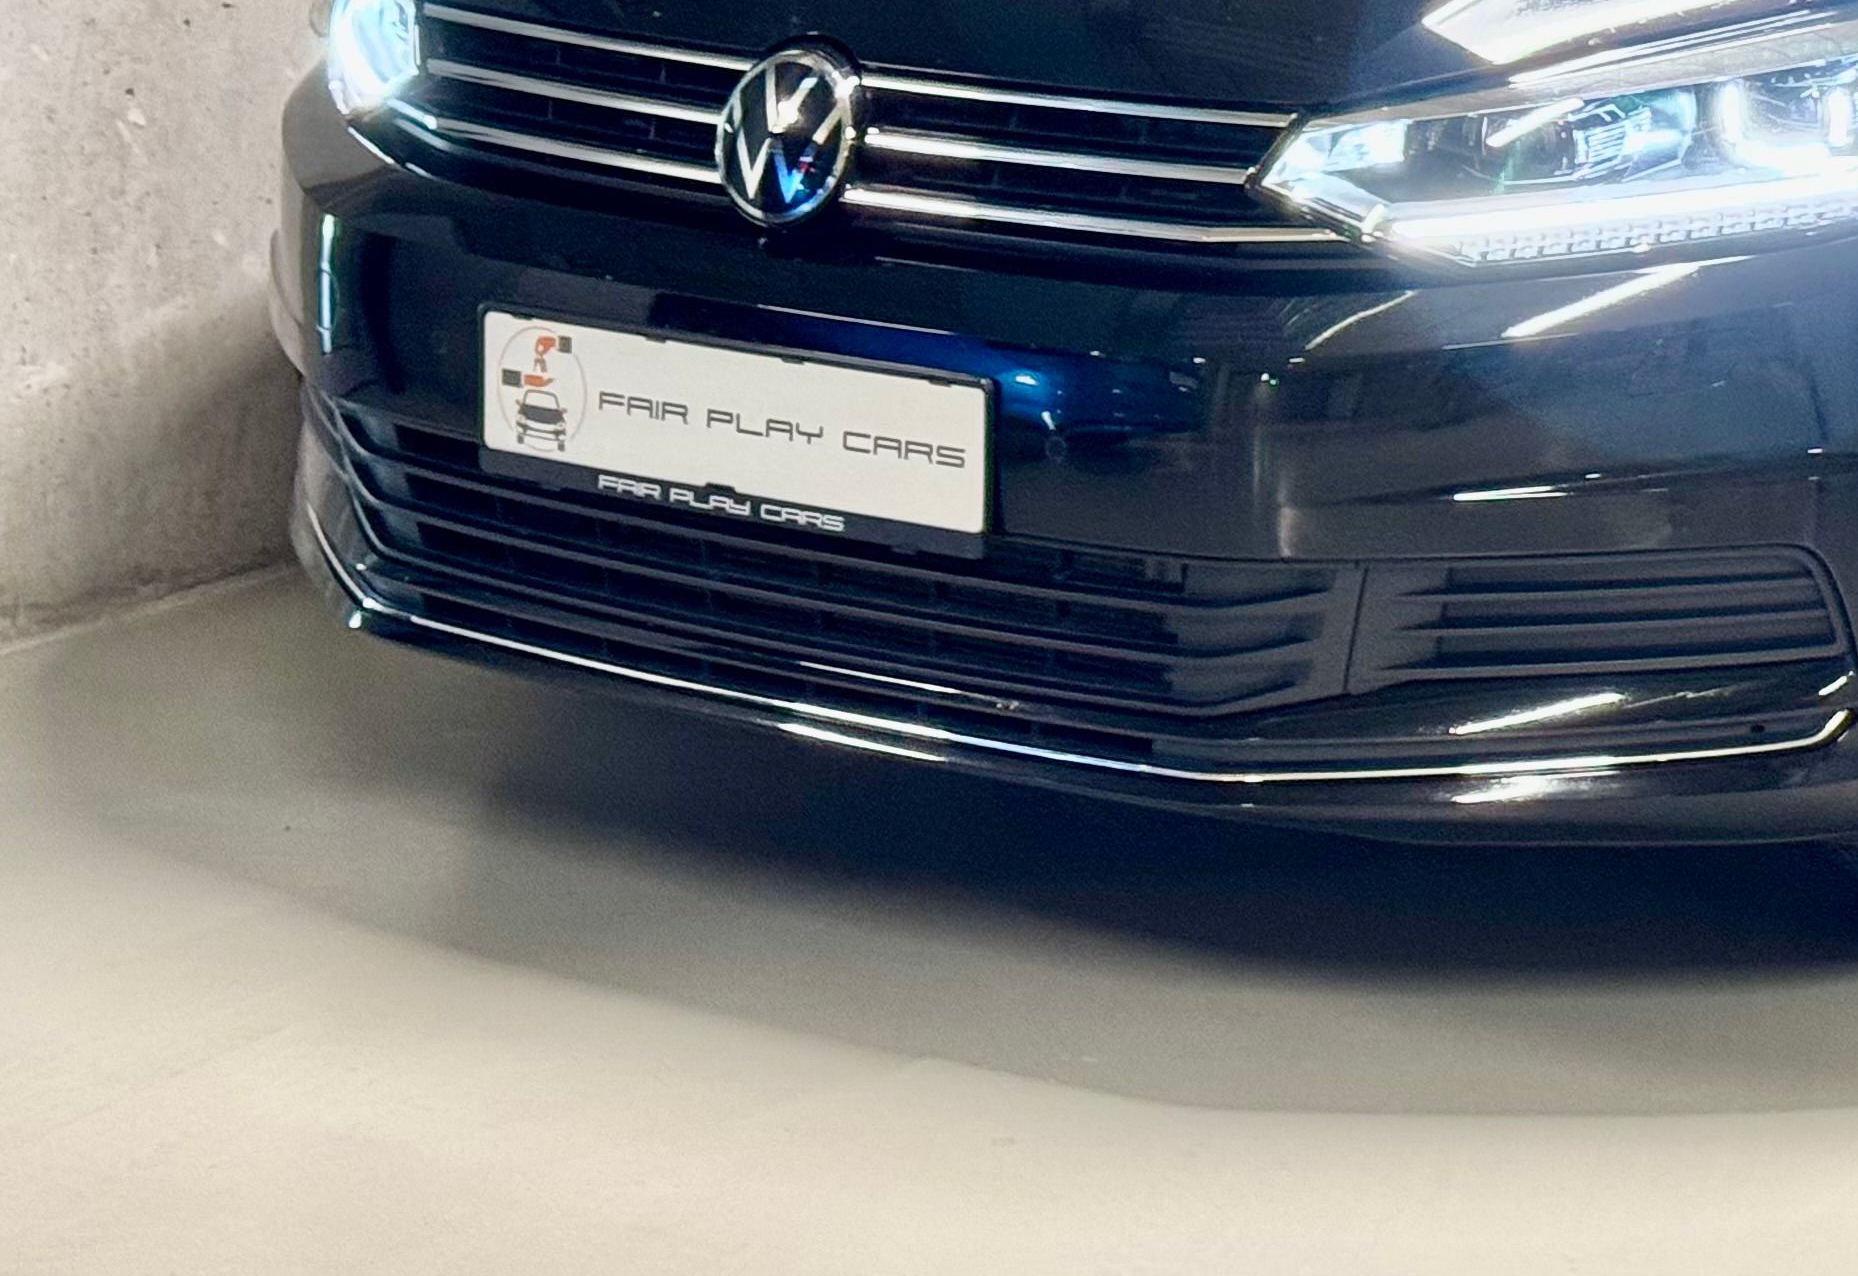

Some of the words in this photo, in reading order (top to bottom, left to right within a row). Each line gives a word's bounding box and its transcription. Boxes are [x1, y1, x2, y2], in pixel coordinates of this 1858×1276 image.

[717, 53, 850, 220] VW
[598, 391, 688, 425] FAIR
[706, 408, 824, 445] PLAY
[843, 430, 966, 469] CARS
[598, 474, 661, 500] FAIR
[669, 488, 750, 516] PLAY
[760, 503, 845, 532] CARS
